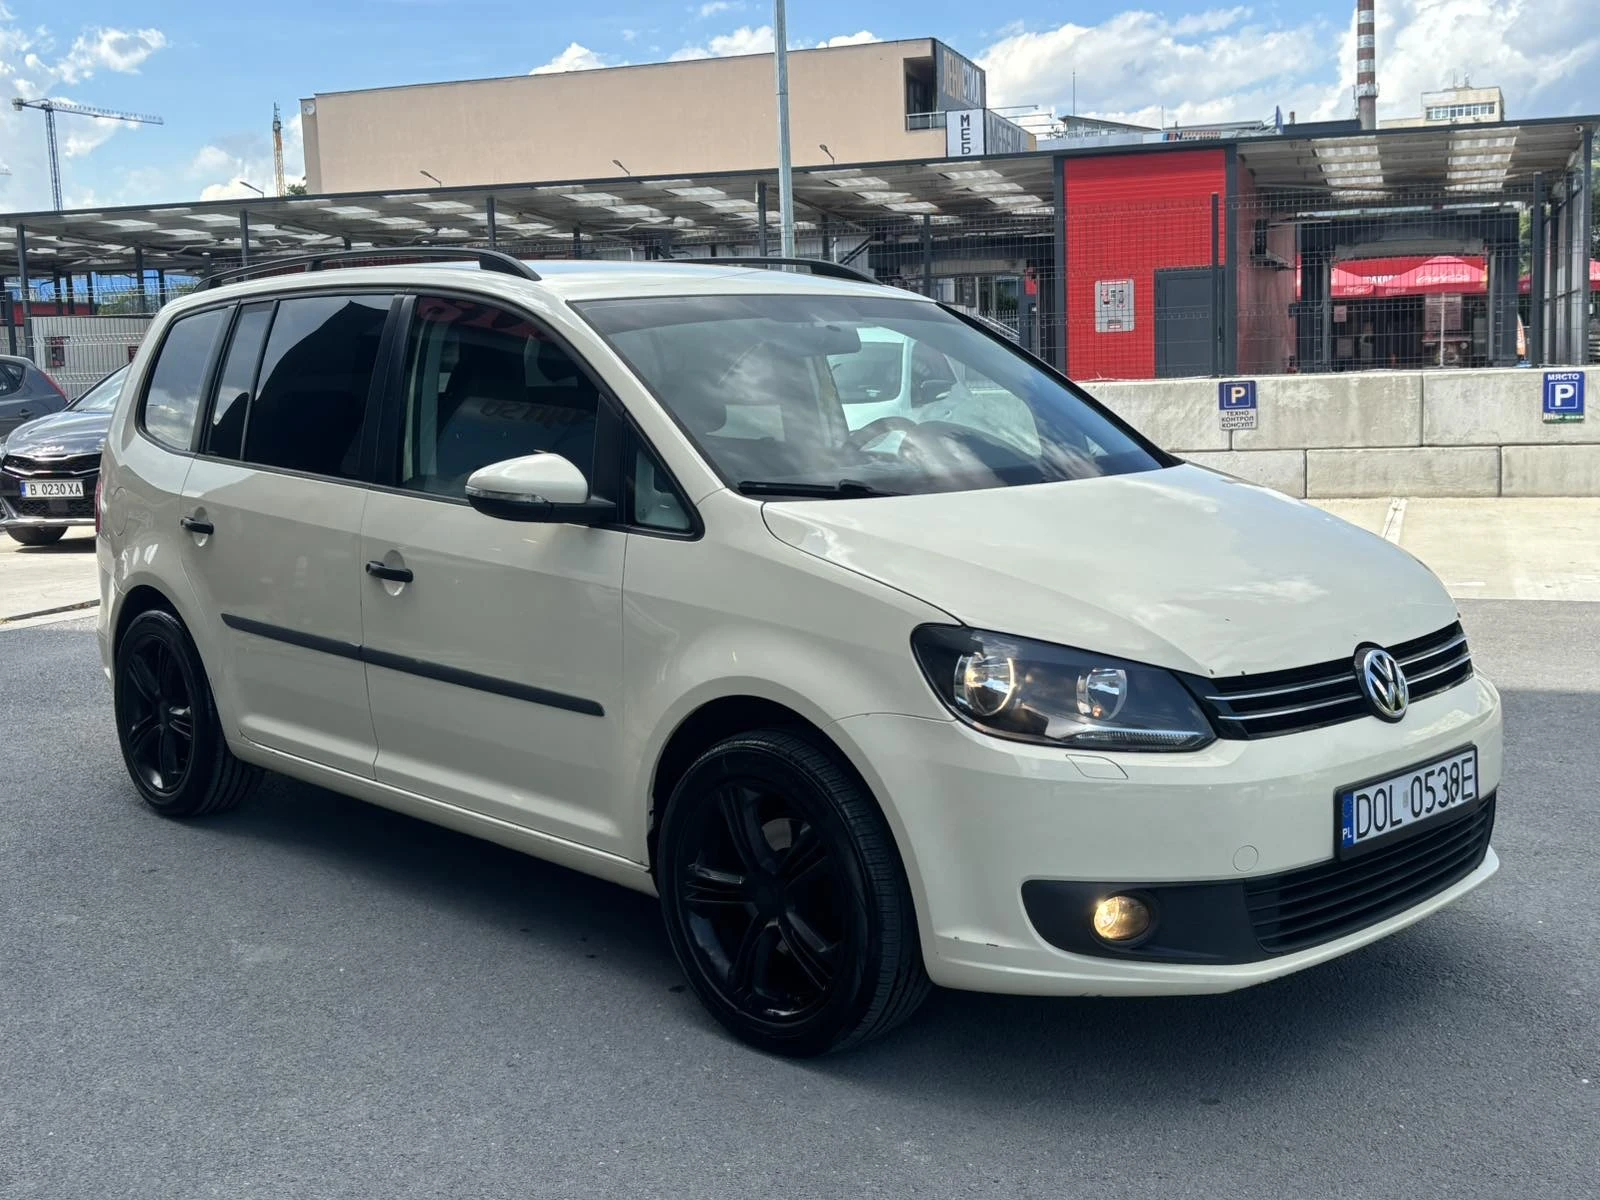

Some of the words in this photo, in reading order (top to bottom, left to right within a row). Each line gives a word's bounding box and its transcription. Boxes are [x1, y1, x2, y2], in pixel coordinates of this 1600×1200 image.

[1547, 373, 1580, 381] МЯСТО
[1231, 386, 1246, 404] P
[1555, 384, 1575, 406] P
[41, 483, 66, 496] 0230
[1356, 784, 1403, 840] DOL
[1411, 757, 1474, 818] 0538E
[1342, 828, 1353, 841] PL
